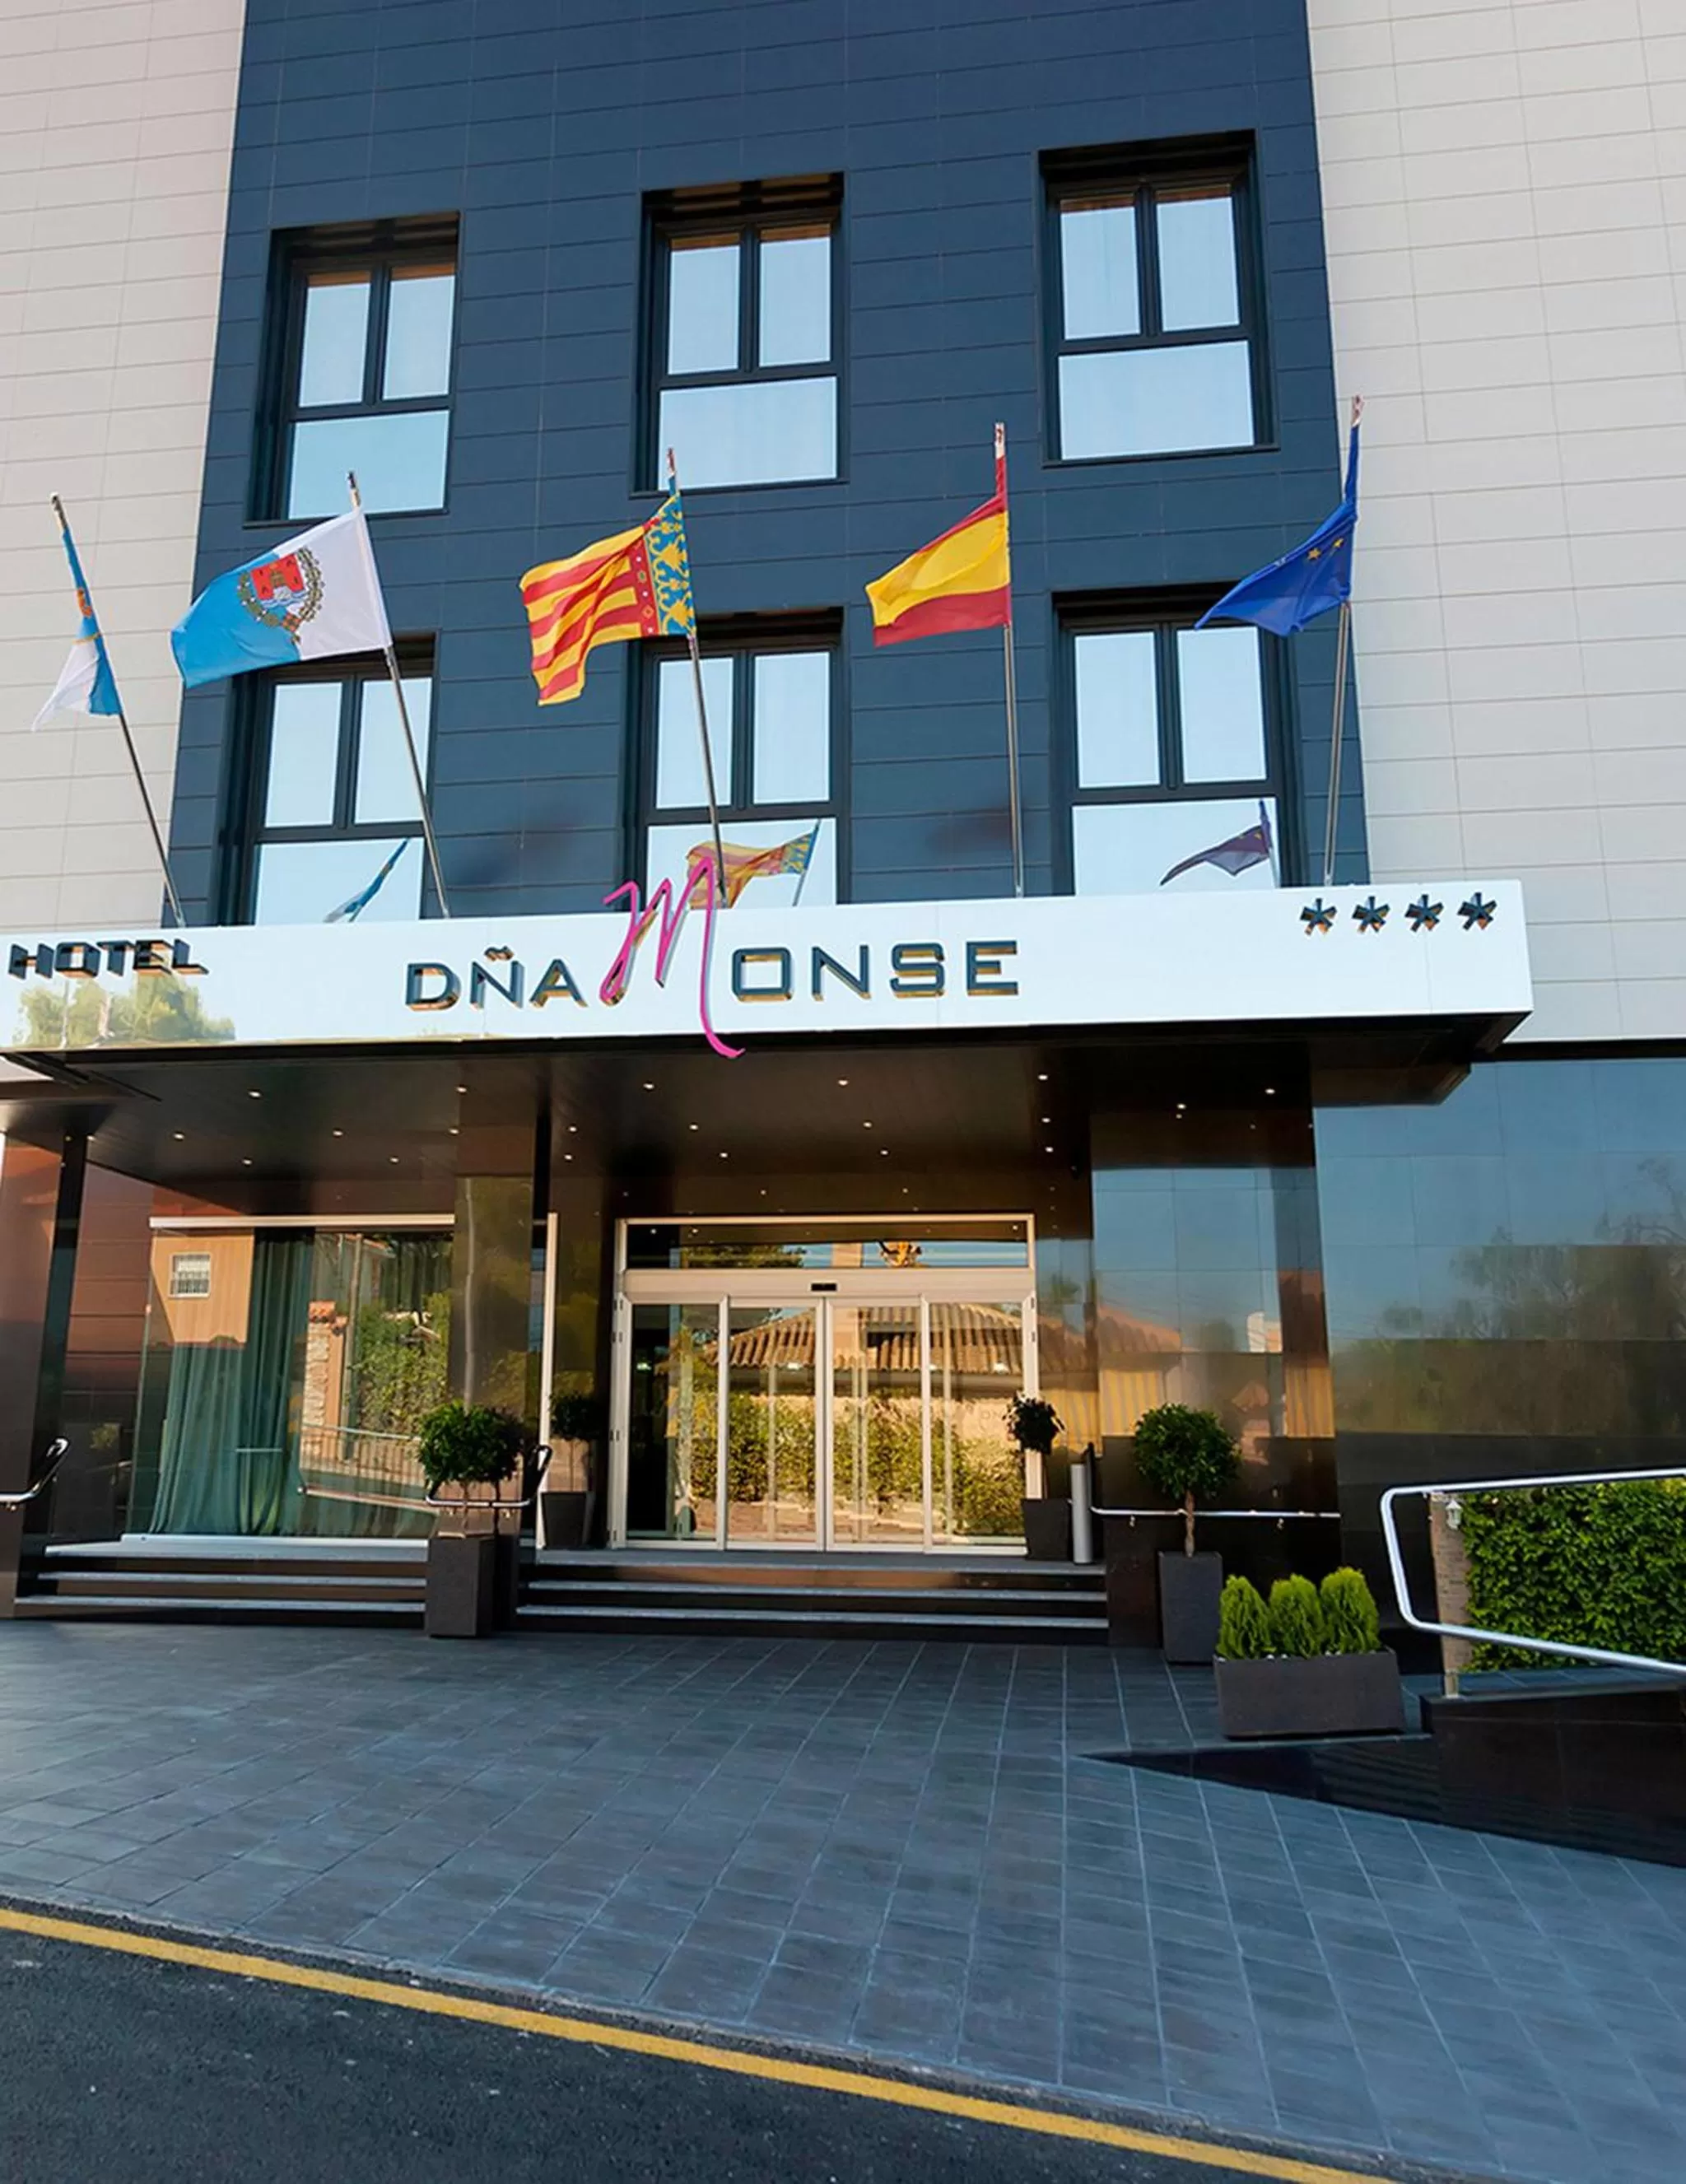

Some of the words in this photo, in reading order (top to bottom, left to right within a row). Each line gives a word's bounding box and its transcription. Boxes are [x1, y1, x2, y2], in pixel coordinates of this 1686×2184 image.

[8, 938, 209, 980] HOTEL
[404, 946, 586, 1012] DÑA
[602, 856, 1019, 1058] MONSE
